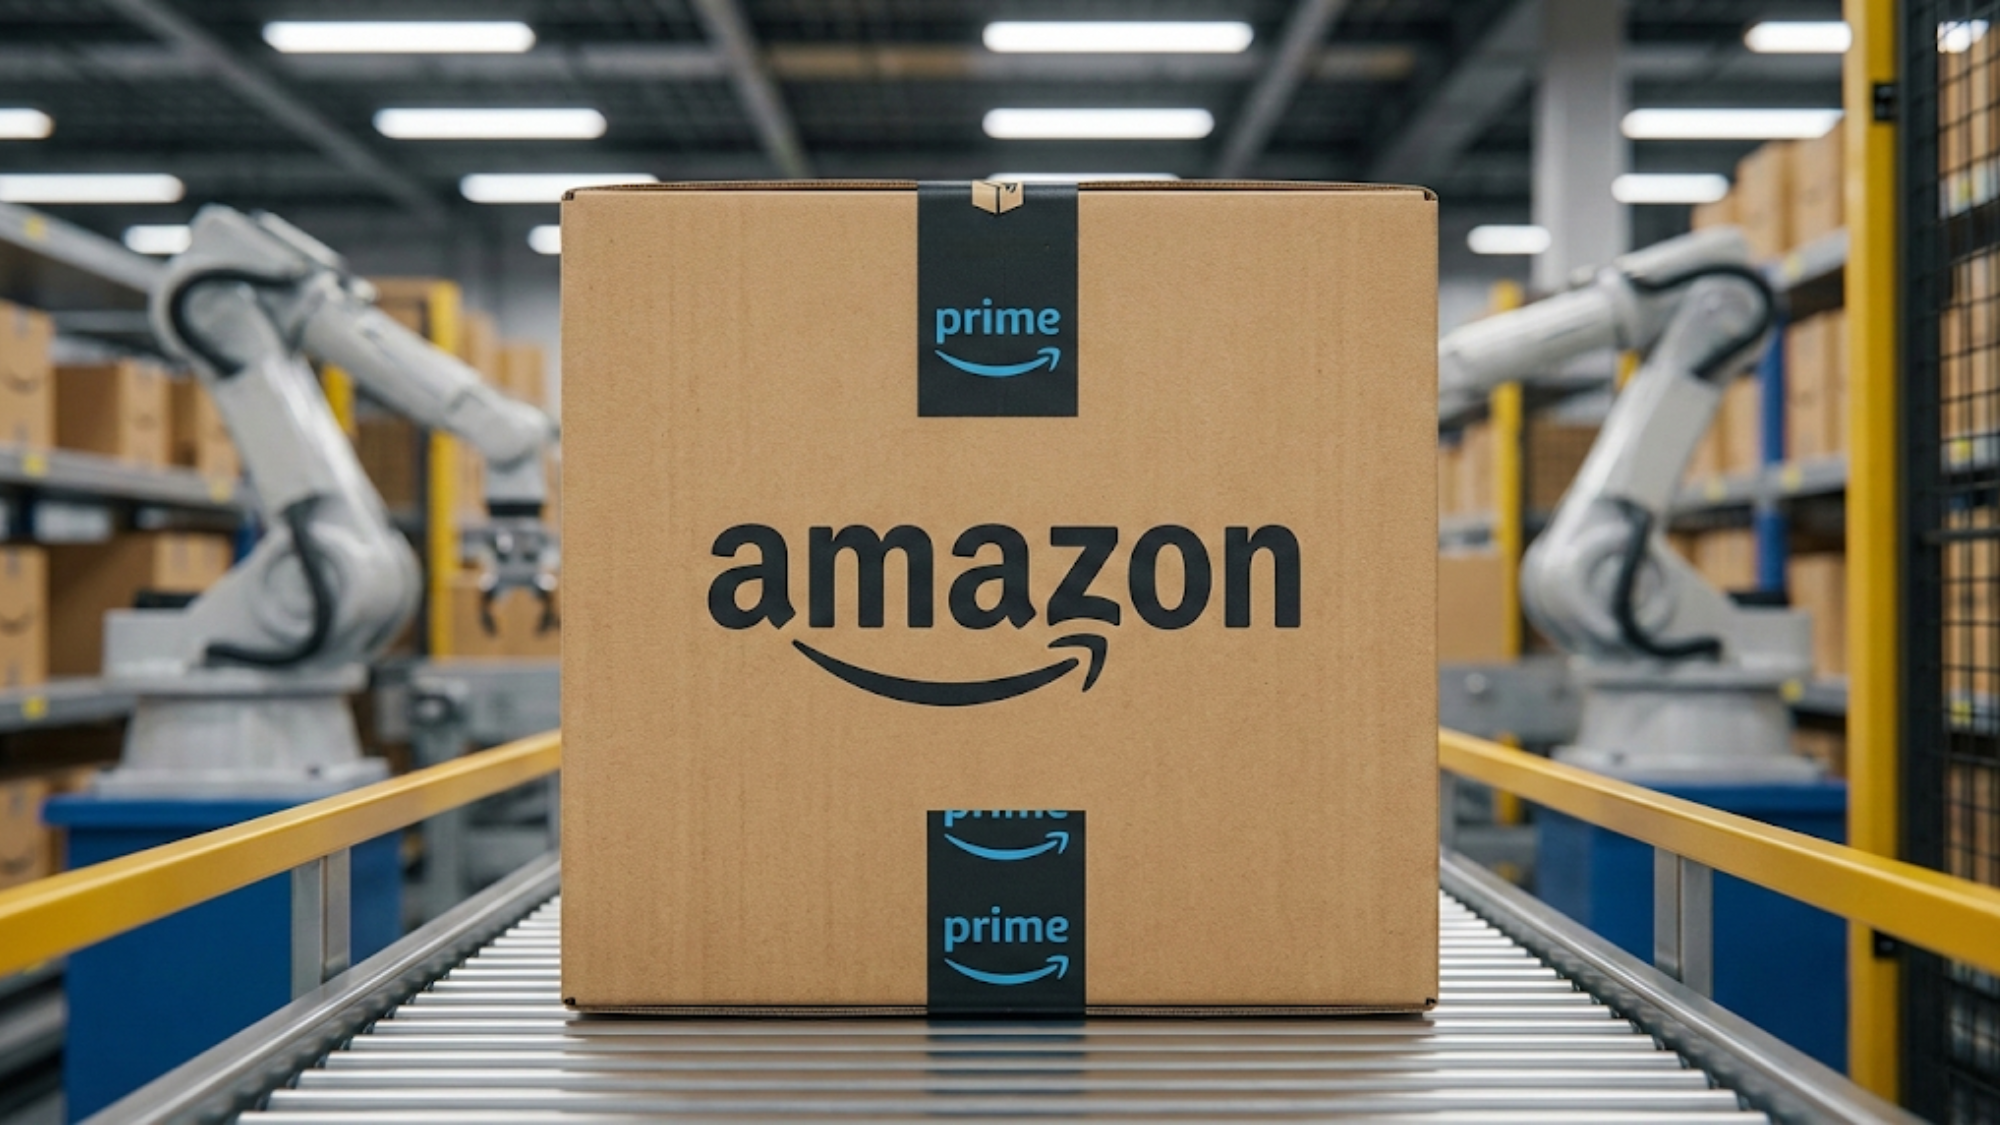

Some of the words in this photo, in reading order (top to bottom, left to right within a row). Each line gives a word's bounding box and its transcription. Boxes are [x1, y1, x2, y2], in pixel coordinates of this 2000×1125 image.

[935, 298, 1061, 344] prime
[707, 523, 1301, 630] amazon
[944, 905, 1069, 952] prime
